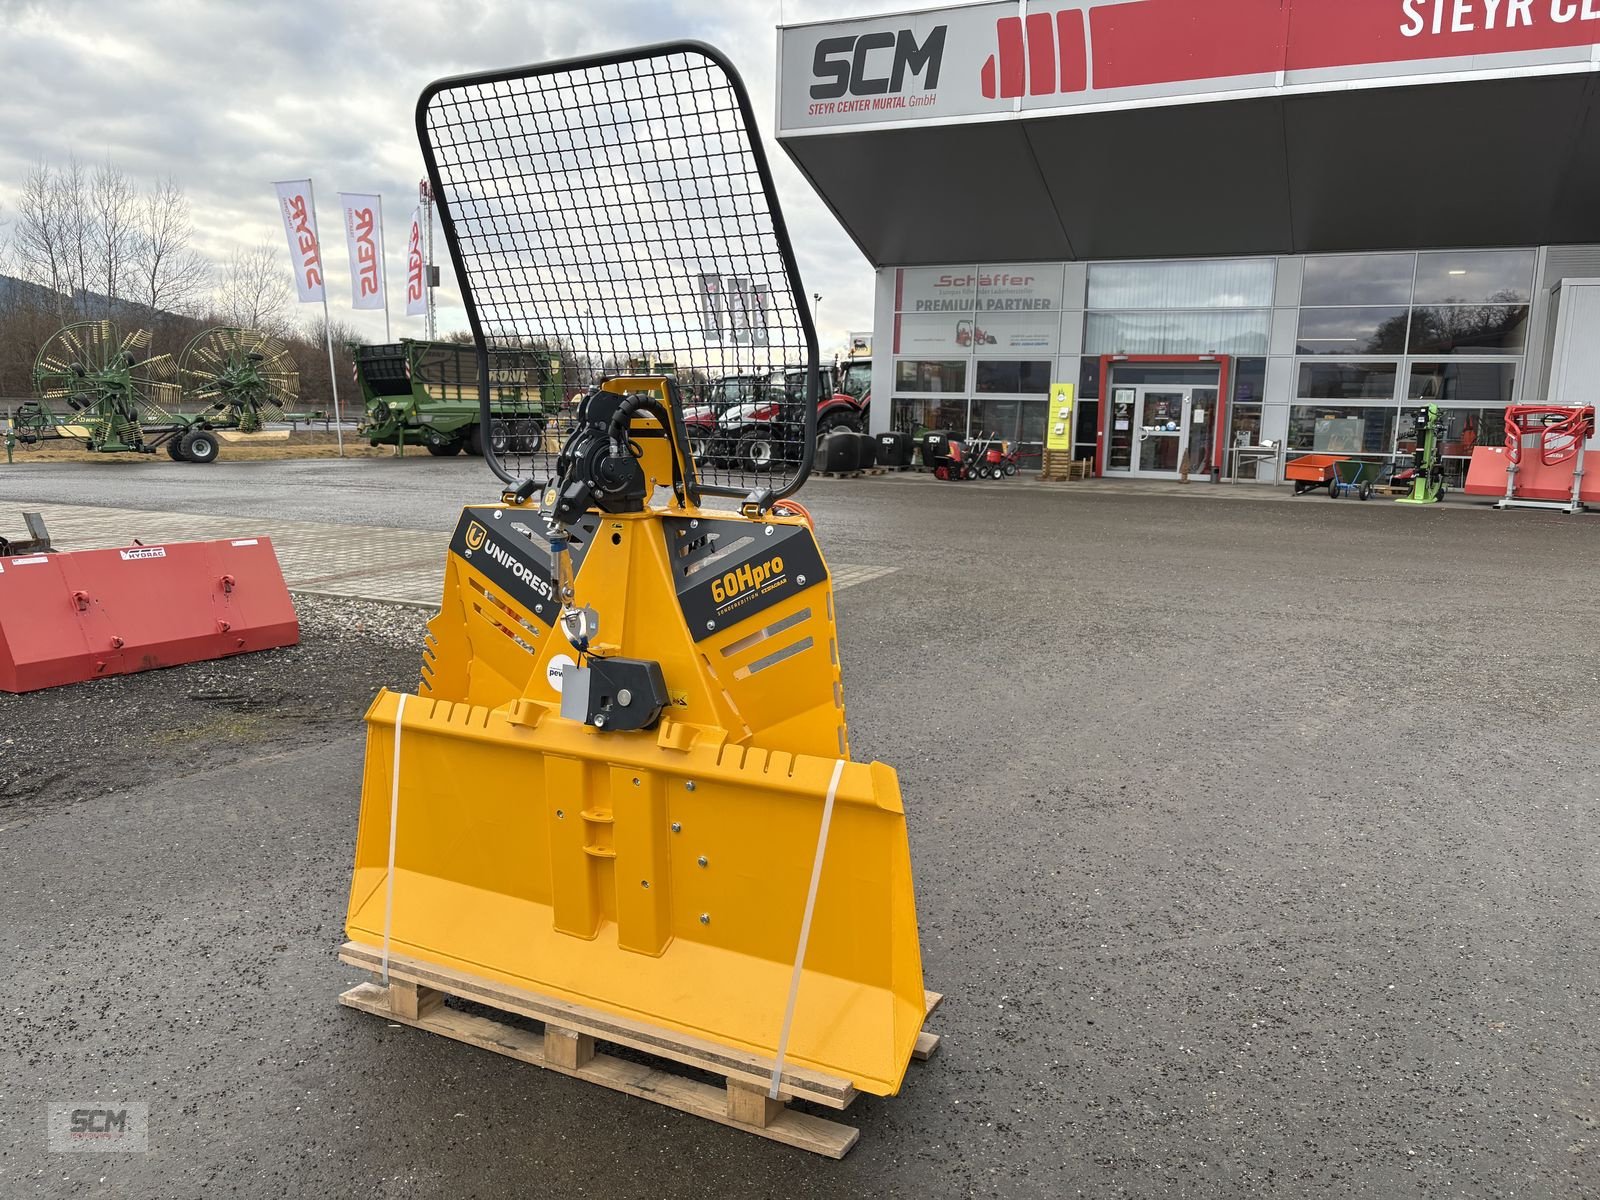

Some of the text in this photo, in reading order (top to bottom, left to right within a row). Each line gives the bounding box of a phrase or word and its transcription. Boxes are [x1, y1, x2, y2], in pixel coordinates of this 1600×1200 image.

[810, 25, 947, 100] SCM
[809, 94, 936, 115] STEYR CENTER MURTAL GmbH
[934, 274, 1035, 287] Schäffer
[916, 298, 1051, 311] PREMIUM PARTNER
[129, 551, 163, 559] HYDRAC
[484, 539, 553, 601] UNIFOREST
[711, 556, 784, 603] 60Hpro
